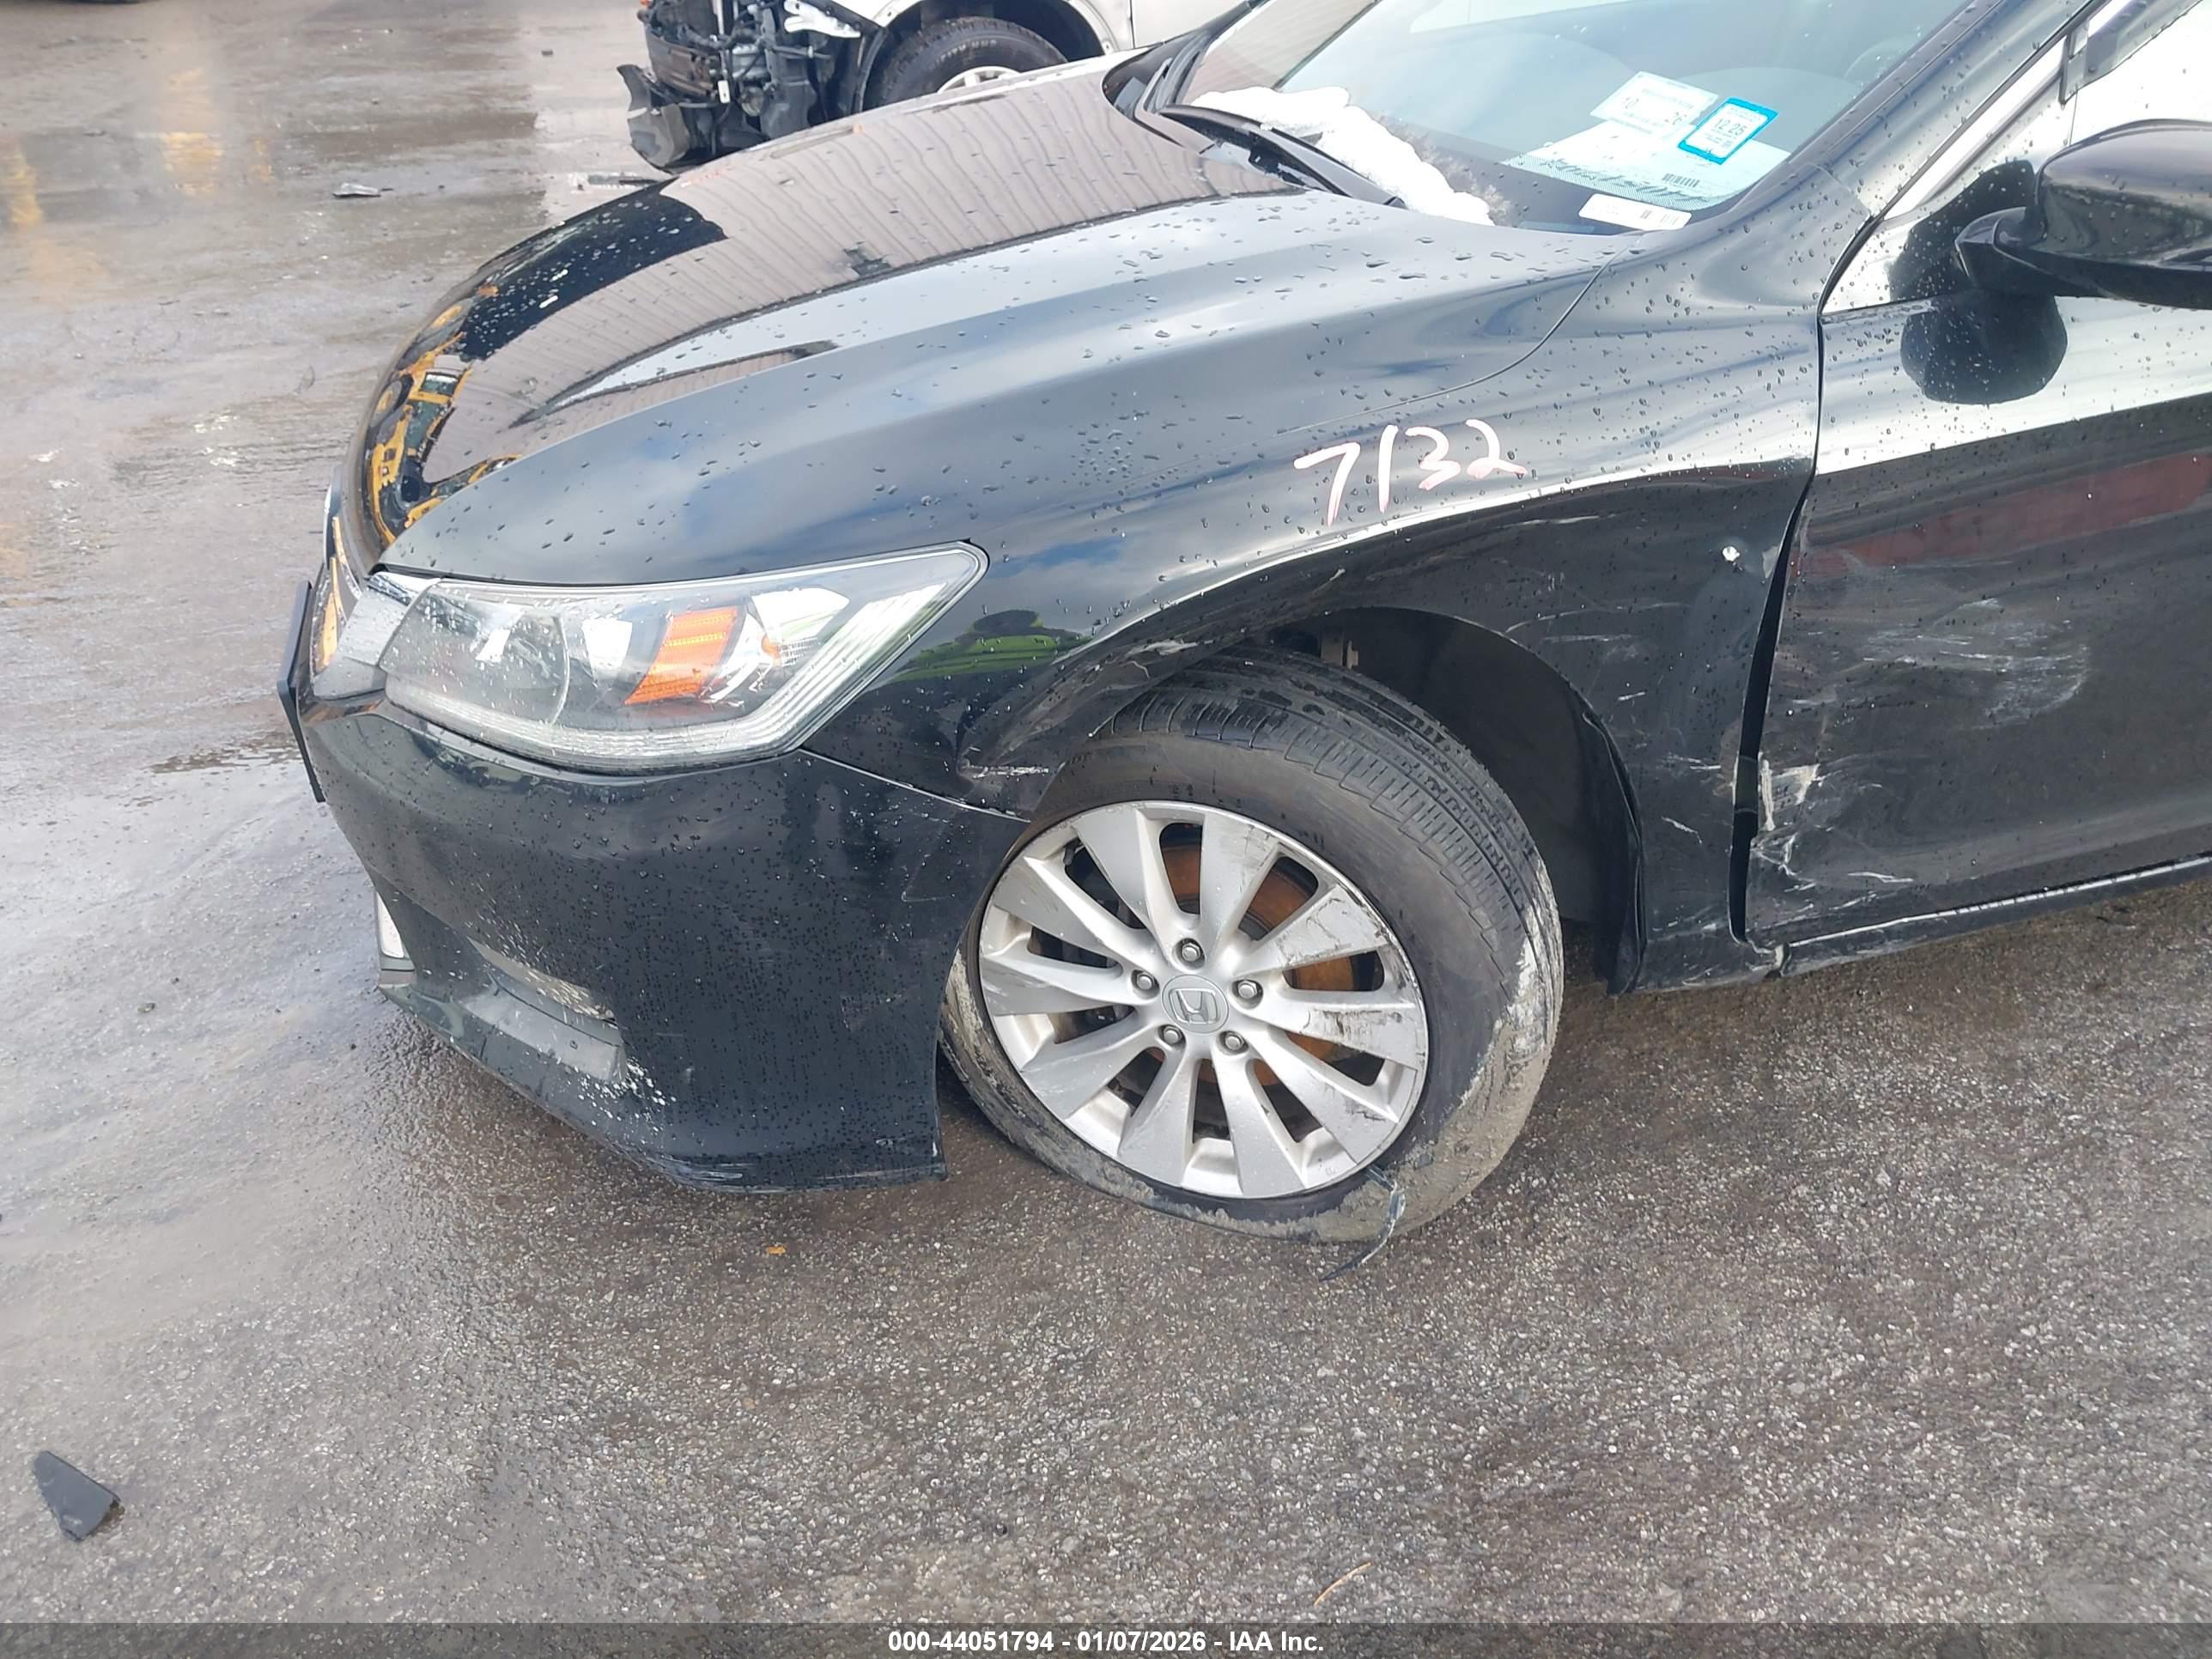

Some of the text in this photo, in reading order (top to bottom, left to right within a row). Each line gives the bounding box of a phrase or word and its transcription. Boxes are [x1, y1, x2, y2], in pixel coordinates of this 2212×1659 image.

[1715, 118, 1747, 137] 12 25
[1293, 419, 1527, 527] 7132
